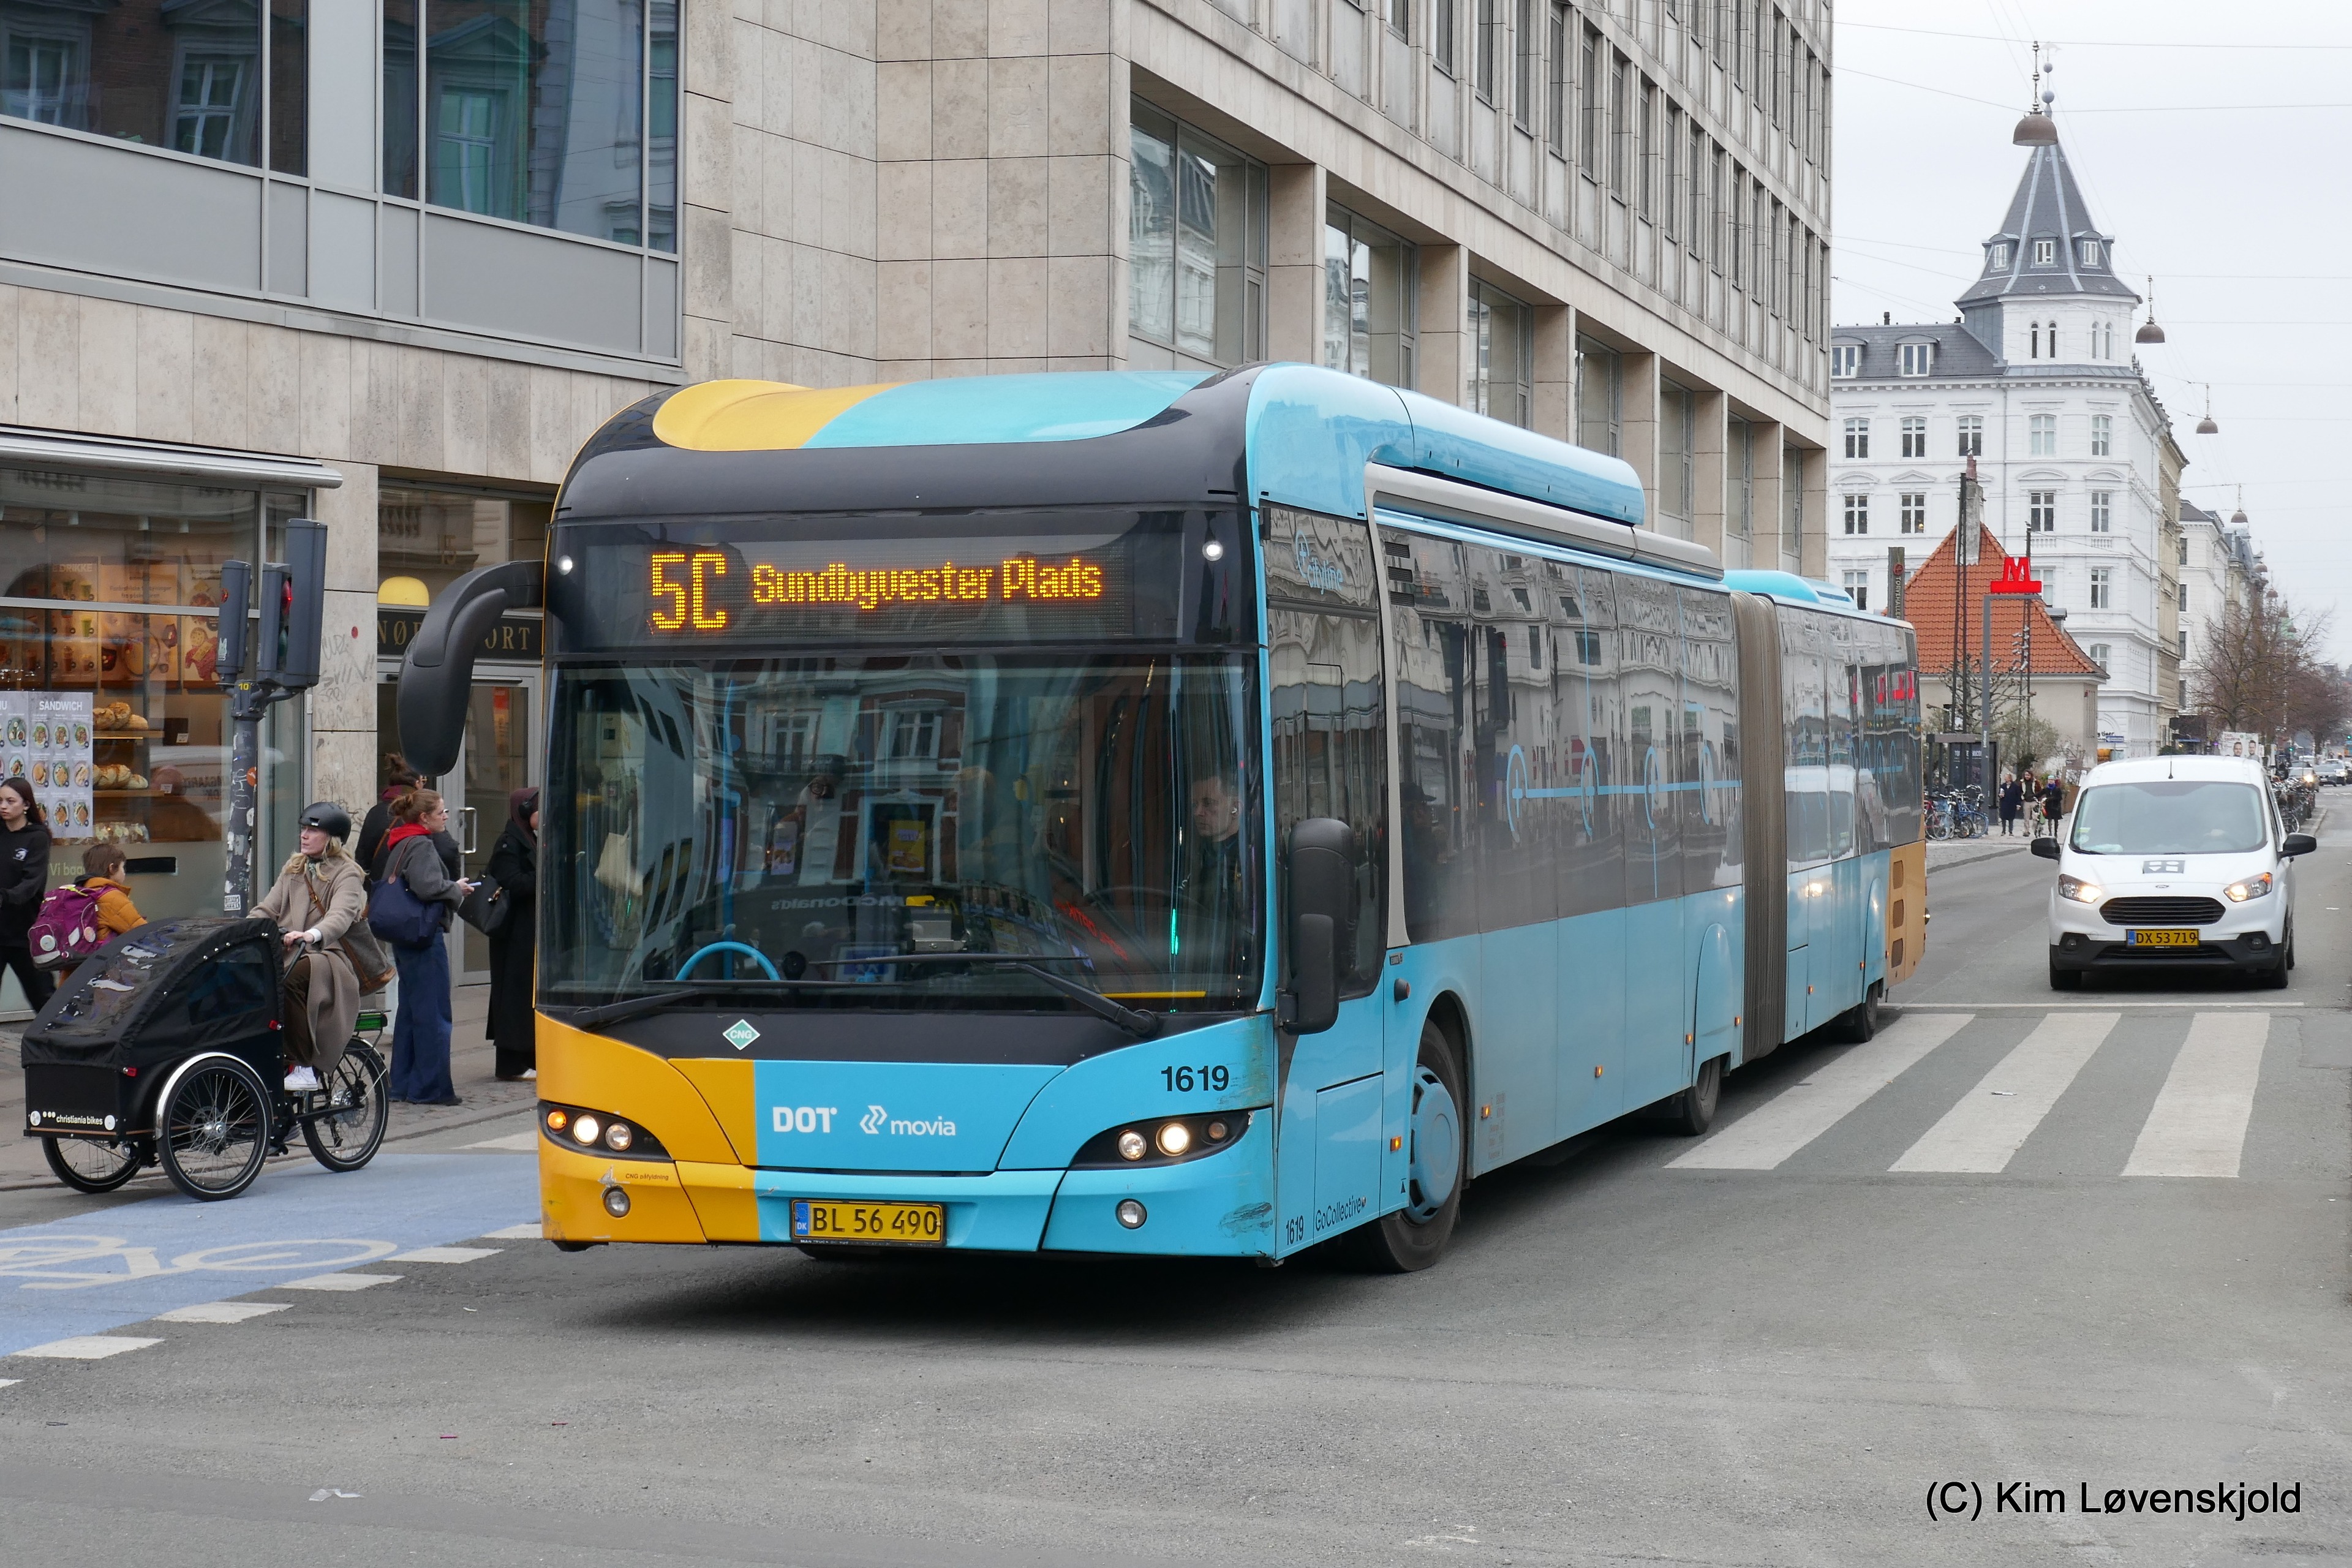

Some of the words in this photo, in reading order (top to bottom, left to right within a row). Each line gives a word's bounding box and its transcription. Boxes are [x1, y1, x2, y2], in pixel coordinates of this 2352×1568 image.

[1307, 557, 1343, 595] cityline
[652, 553, 726, 629] 5C
[753, 562, 993, 609] Sundbyvester
[1003, 558, 1101, 598] Plads
[39, 701, 83, 711] SANDWICH
[49, 862, 61, 876] Vi
[2136, 932, 2153, 944] DX
[2156, 932, 2171, 944] 53
[2174, 932, 2196, 944] 719
[729, 1029, 753, 1039] CNG
[1161, 1065, 1229, 1092] 1619
[56, 1114, 86, 1125] christiania
[86, 1115, 104, 1125] bikes
[772, 1106, 832, 1133] DOT
[891, 1115, 956, 1136] movia
[797, 1222, 807, 1231] DK
[813, 1207, 845, 1233] BL
[853, 1208, 884, 1234] 56
[892, 1209, 938, 1236] 490
[1315, 1195, 1361, 1232] GoCollective
[1286, 1215, 1304, 1245] 1619
